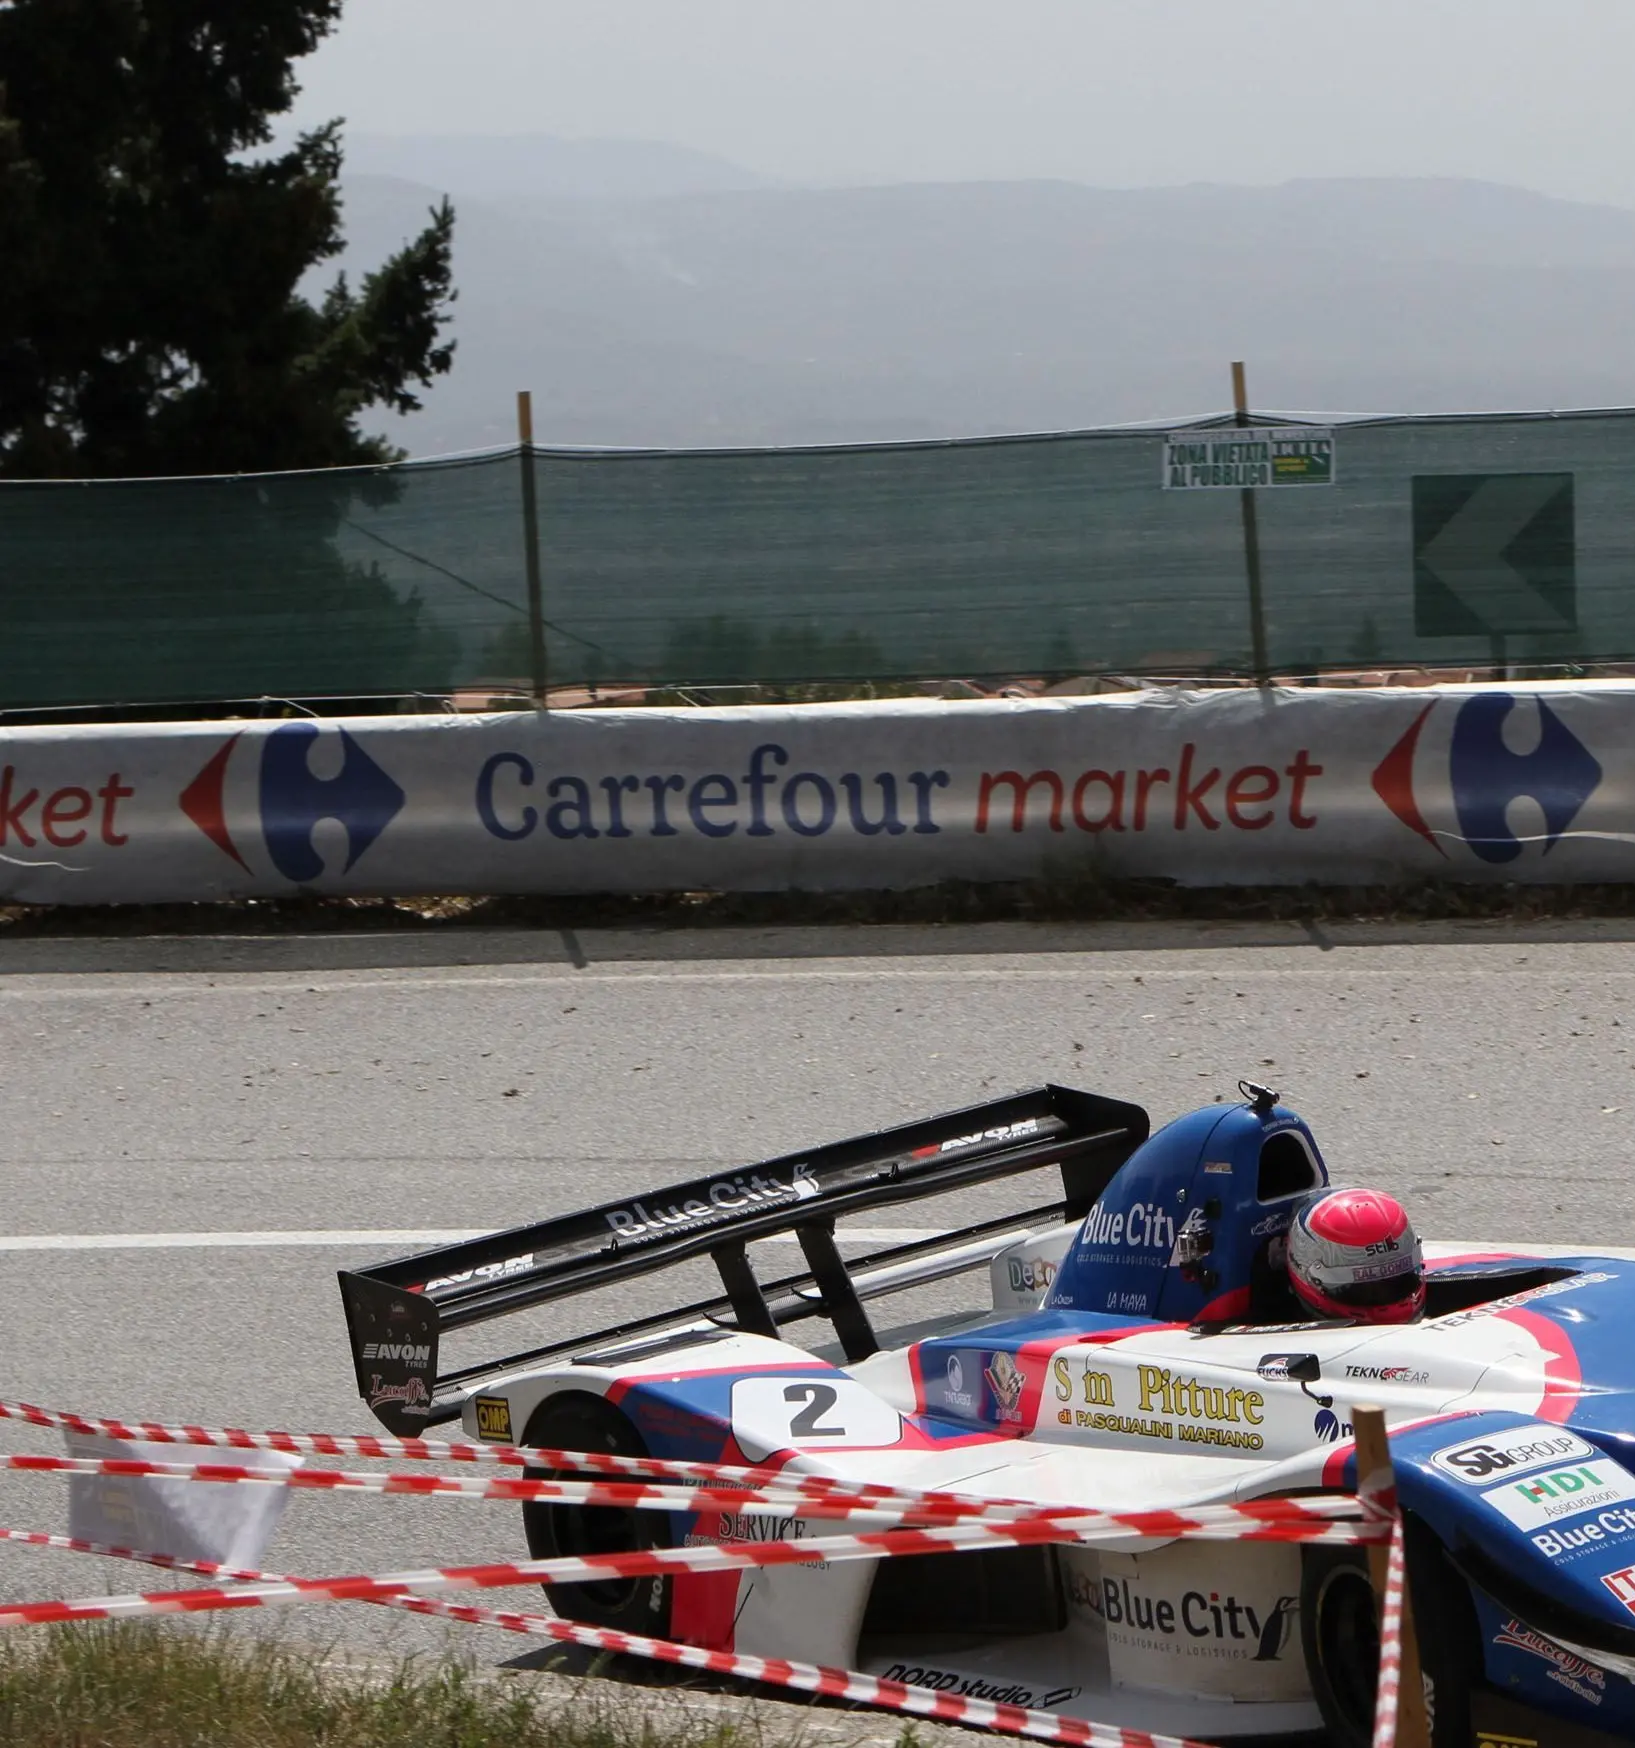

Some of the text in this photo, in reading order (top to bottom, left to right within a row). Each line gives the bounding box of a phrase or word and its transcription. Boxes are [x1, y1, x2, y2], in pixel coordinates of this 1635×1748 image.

[1168, 444, 1207, 466] ZONA
[1213, 442, 1268, 464] VIETATA
[1170, 466, 1187, 487] AL
[1190, 464, 1268, 486] PUBBLICO
[0, 765, 134, 848] ket
[475, 742, 1323, 841] Carrefour market
[941, 1117, 1038, 1151] AVON
[605, 1174, 795, 1237] Blue City
[1081, 1200, 1175, 1249] Blue City
[425, 1253, 534, 1292] AVON
[377, 1344, 431, 1361] AVON
[405, 1361, 428, 1369] TYRES
[1257, 1365, 1289, 1378] FUCHS
[1054, 1357, 1265, 1426] S m Pitture
[478, 1405, 510, 1432] OMP
[783, 1383, 846, 1437] 2
[1057, 1408, 1263, 1450] di PASQUALINI MARIANO
[1509, 1437, 1577, 1463] GROUP
[1514, 1467, 1604, 1504] HDI
[1543, 1488, 1620, 1517] Assicurazioni
[719, 1512, 806, 1542] SERVICE
[1531, 1523, 1606, 1558] Blue
[1103, 1577, 1175, 1634] Blue
[1181, 1591, 1261, 1640] City
[956, 1678, 1032, 1705] studio
